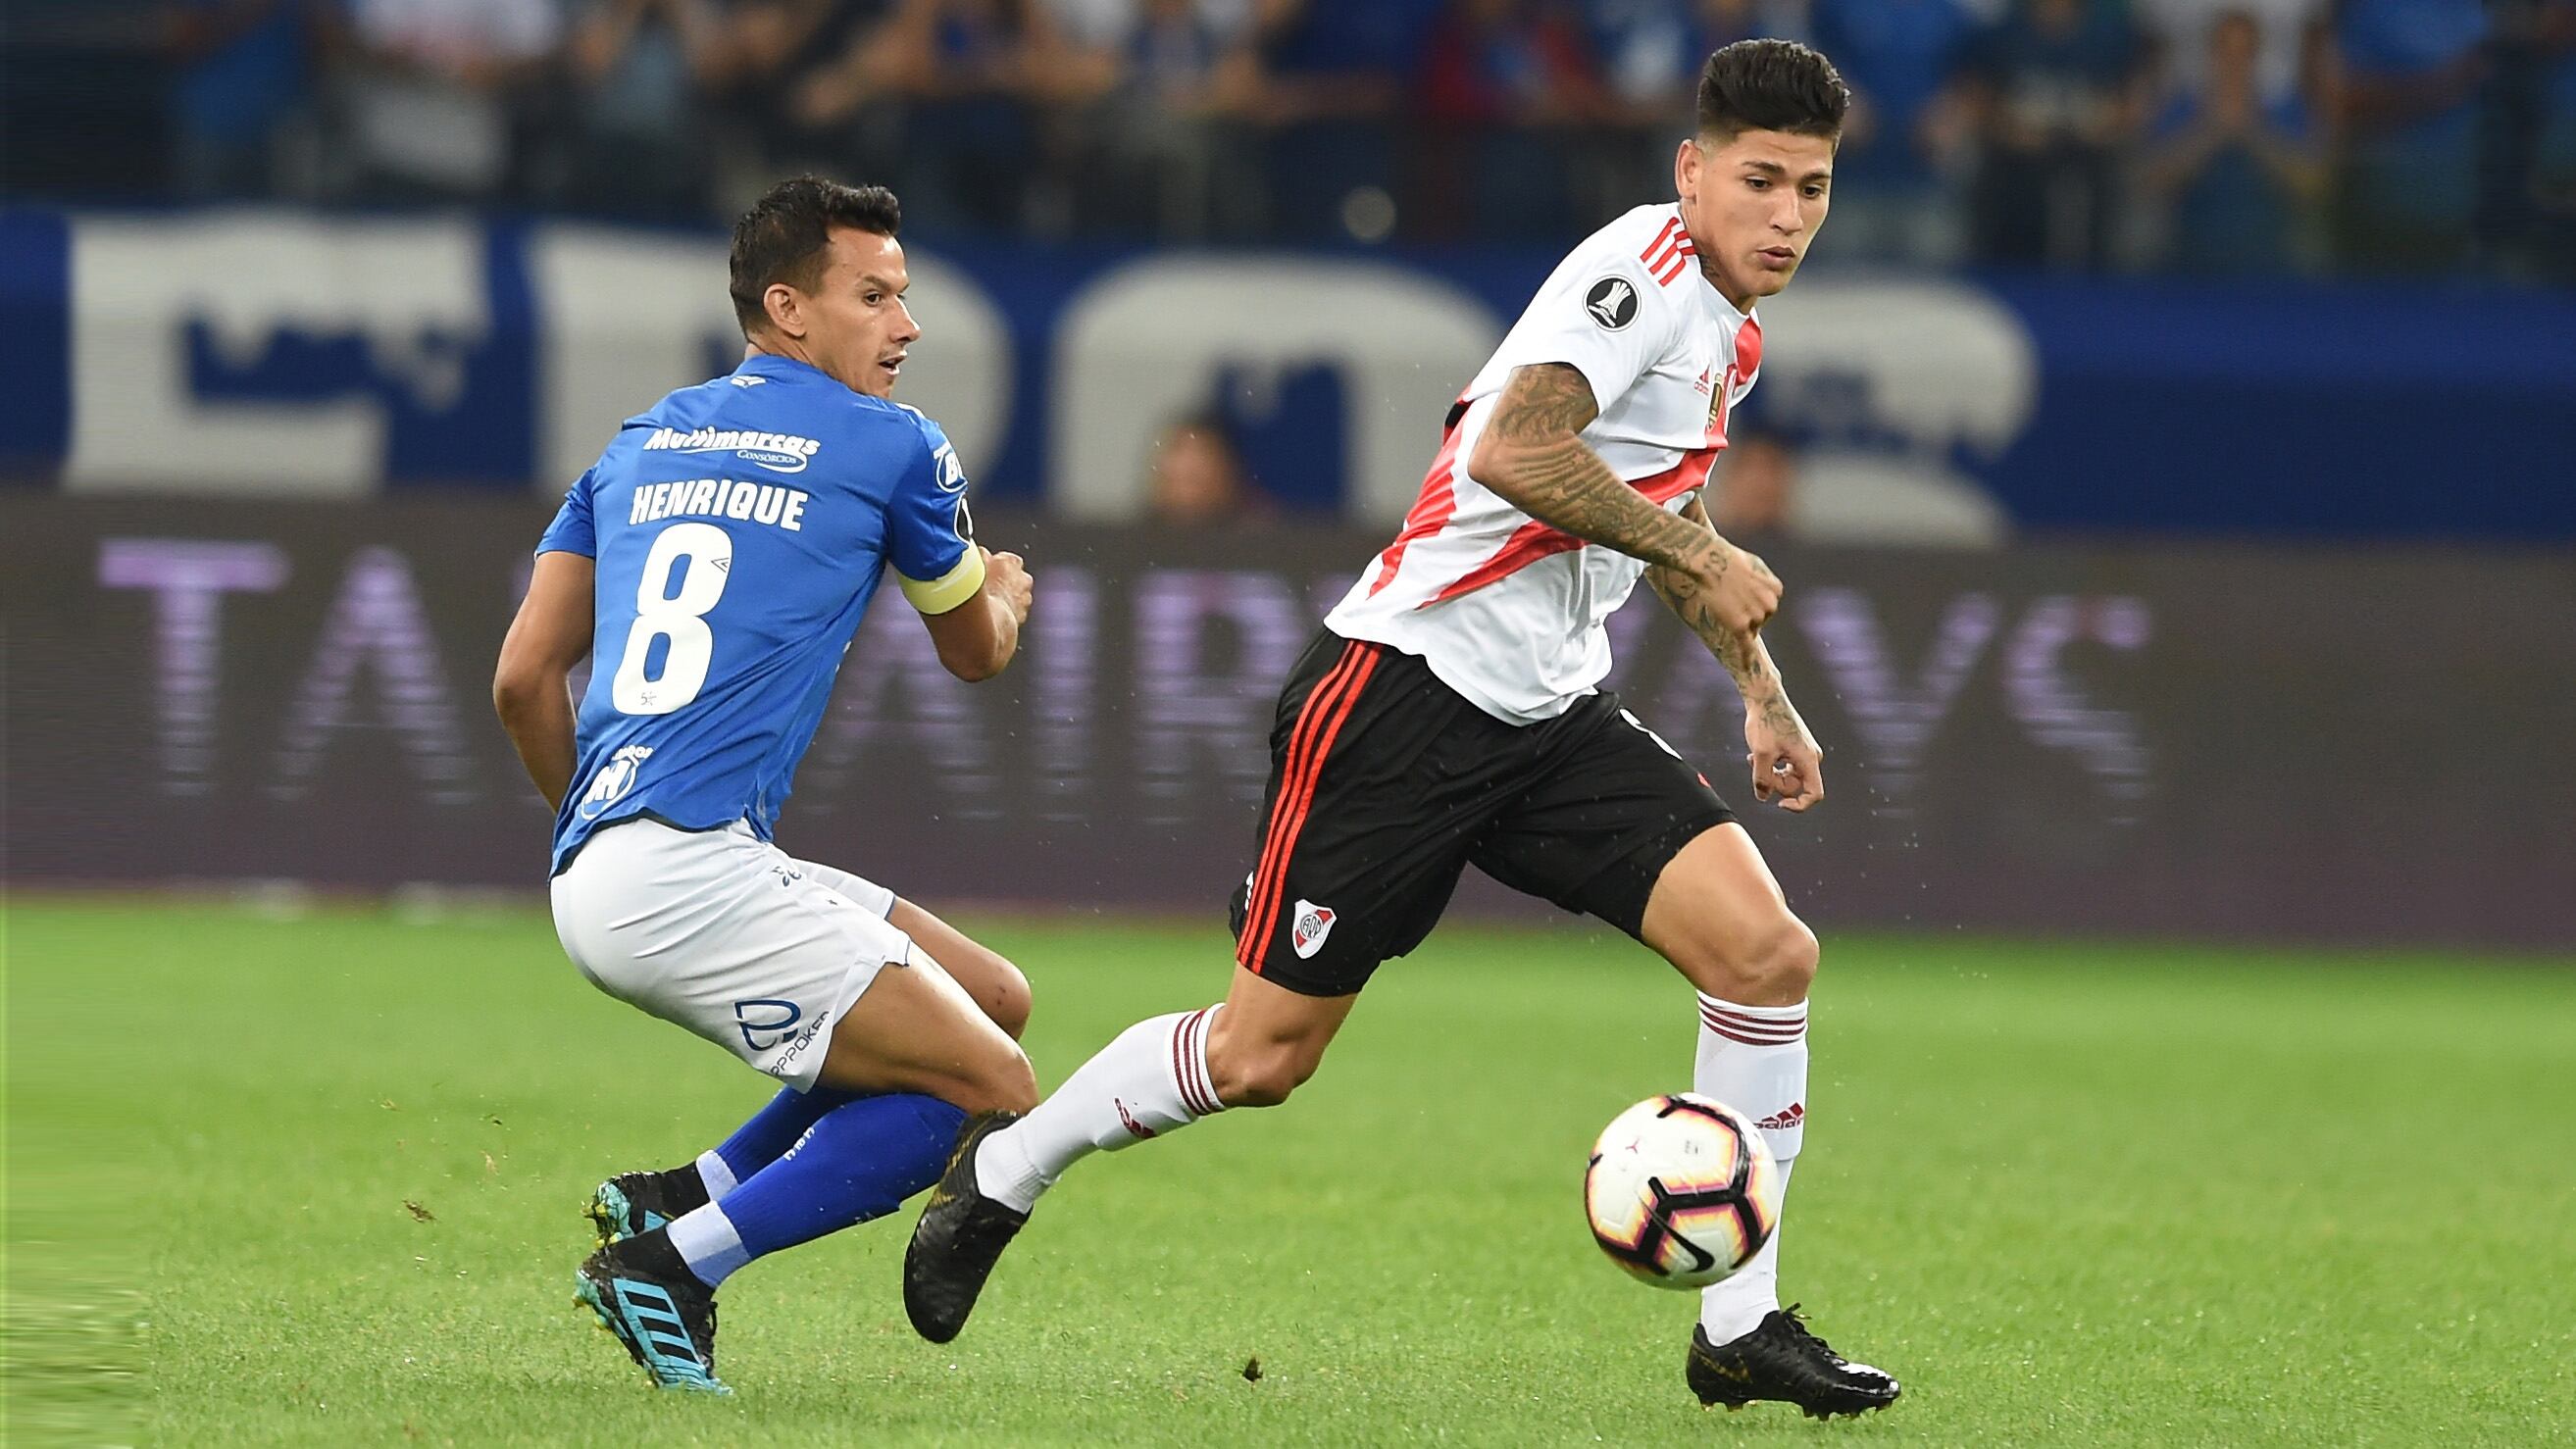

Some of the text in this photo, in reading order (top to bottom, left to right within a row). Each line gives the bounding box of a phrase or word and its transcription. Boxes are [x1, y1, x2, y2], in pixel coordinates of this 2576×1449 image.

[642, 425, 821, 456] Multimarcas
[629, 478, 809, 532] HENRIQUE
[612, 523, 732, 715] 8
